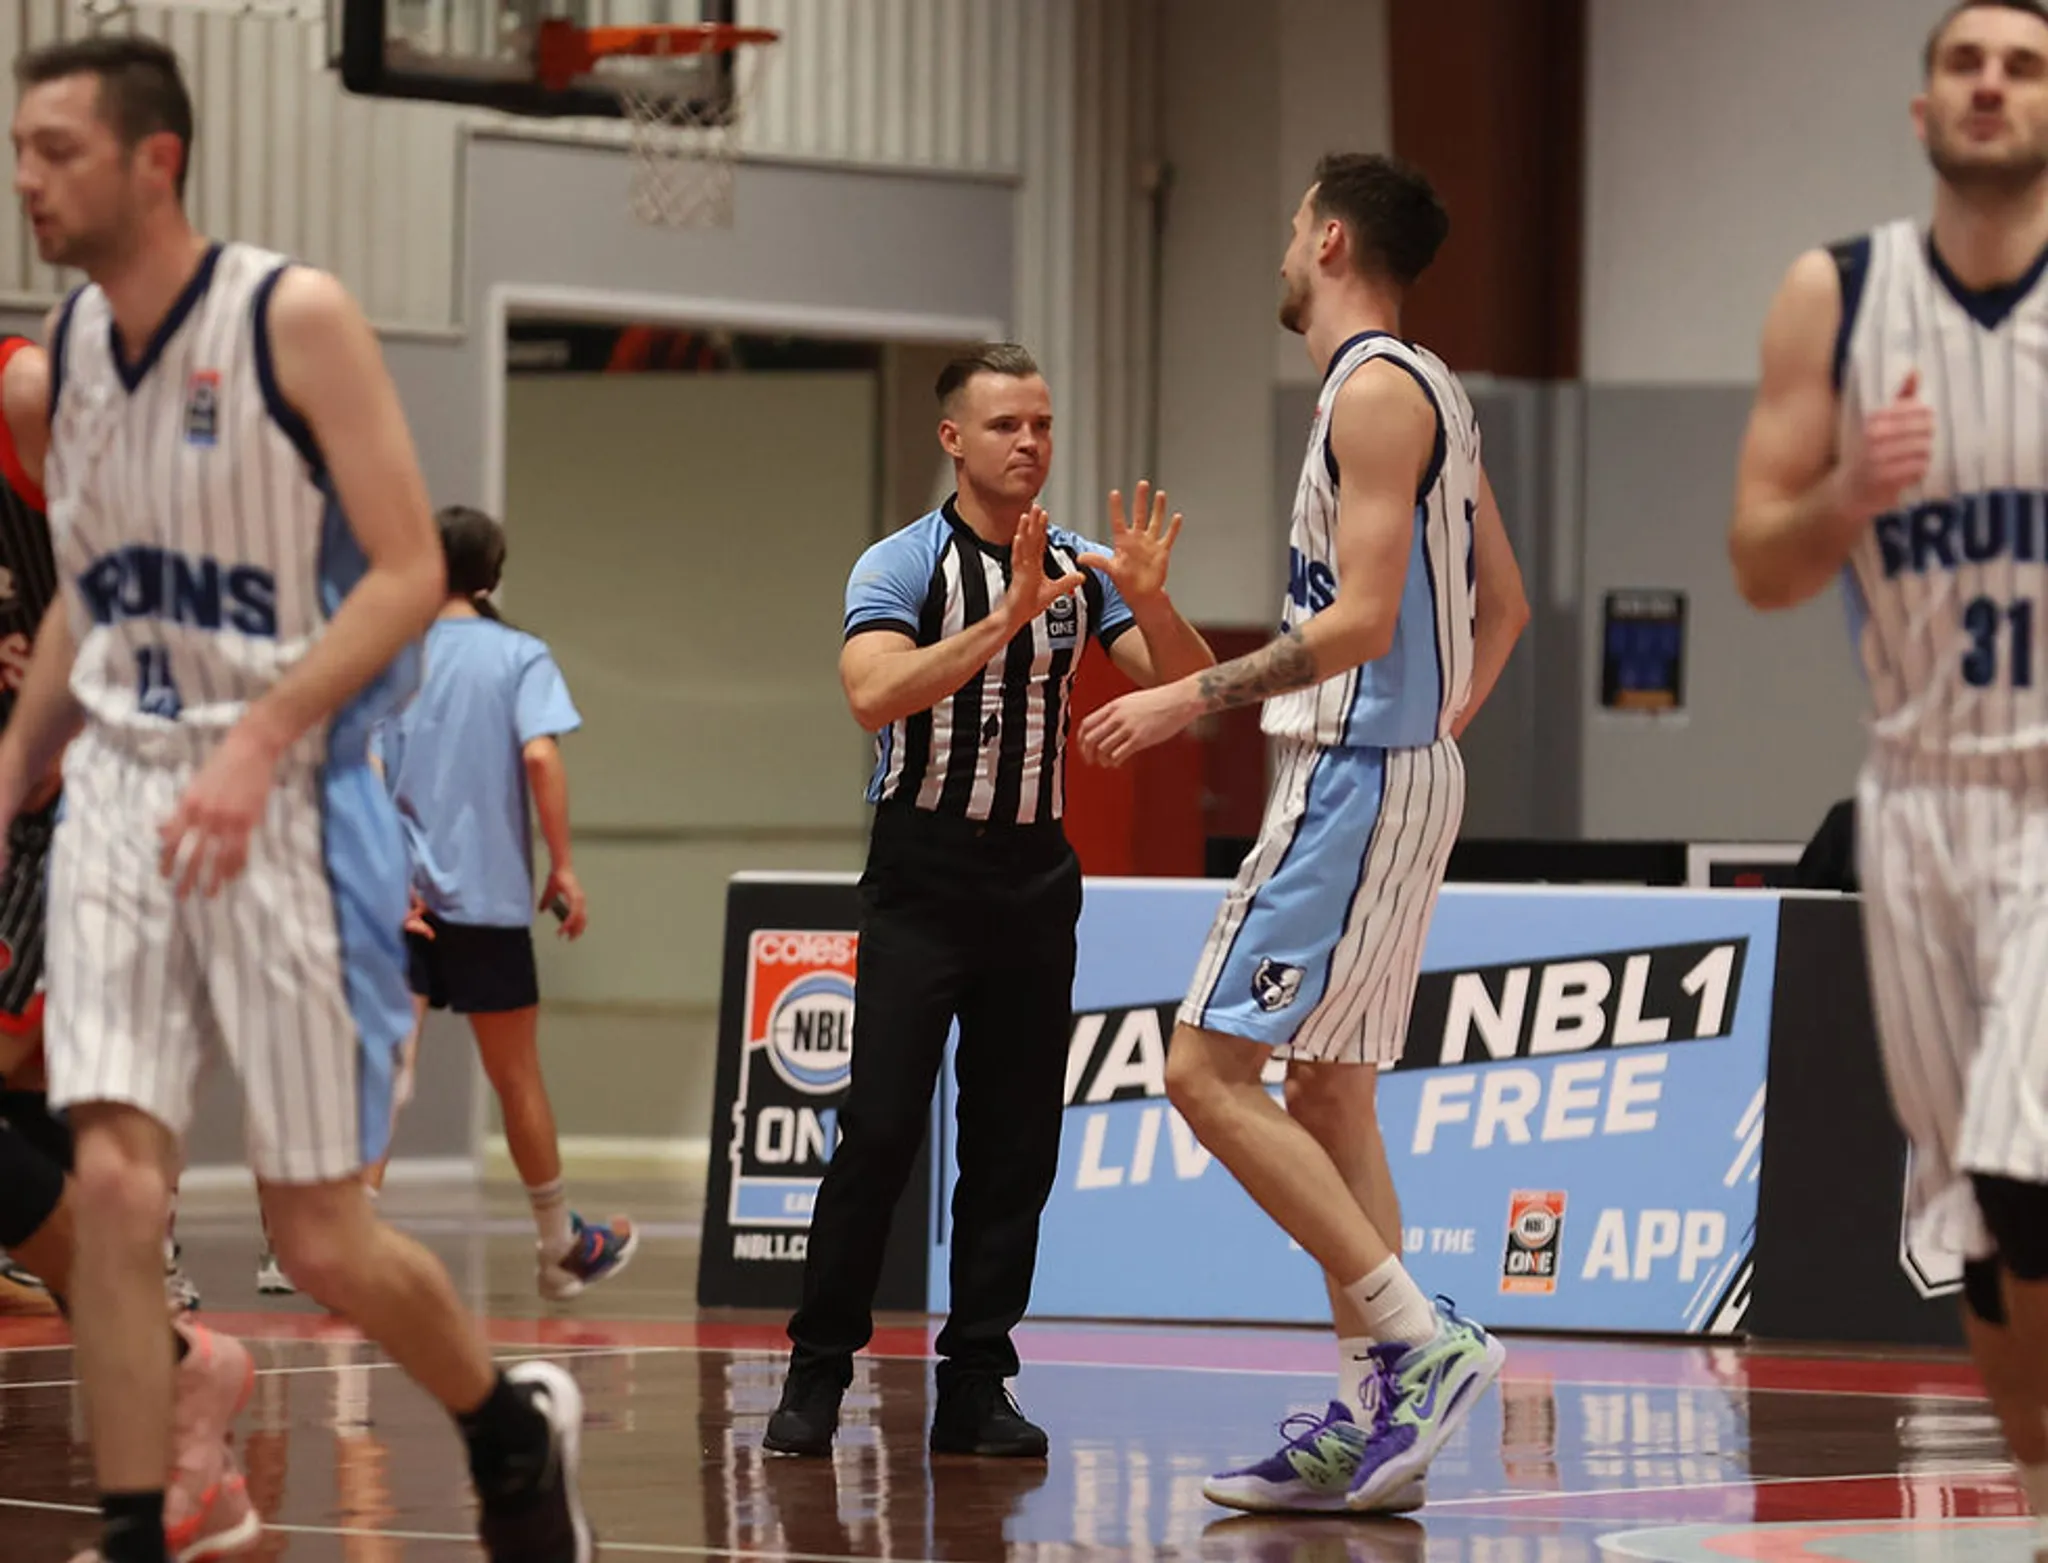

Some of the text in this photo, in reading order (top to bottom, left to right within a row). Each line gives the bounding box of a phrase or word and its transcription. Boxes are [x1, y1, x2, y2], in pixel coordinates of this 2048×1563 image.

[1874, 489, 2048, 580] BRUI
[1050, 620, 1076, 637] ONE
[1961, 599, 2034, 688] 31
[793, 1009, 850, 1052] NBL
[1439, 944, 1737, 1066] NBL1
[755, 1106, 844, 1165] ON
[1410, 1052, 1670, 1156] FREE
[1074, 1105, 1214, 1191] LIV
[1430, 1227, 1477, 1254] THE
[1506, 1249, 1554, 1275] ONE
[1581, 1207, 1728, 1284] APP
